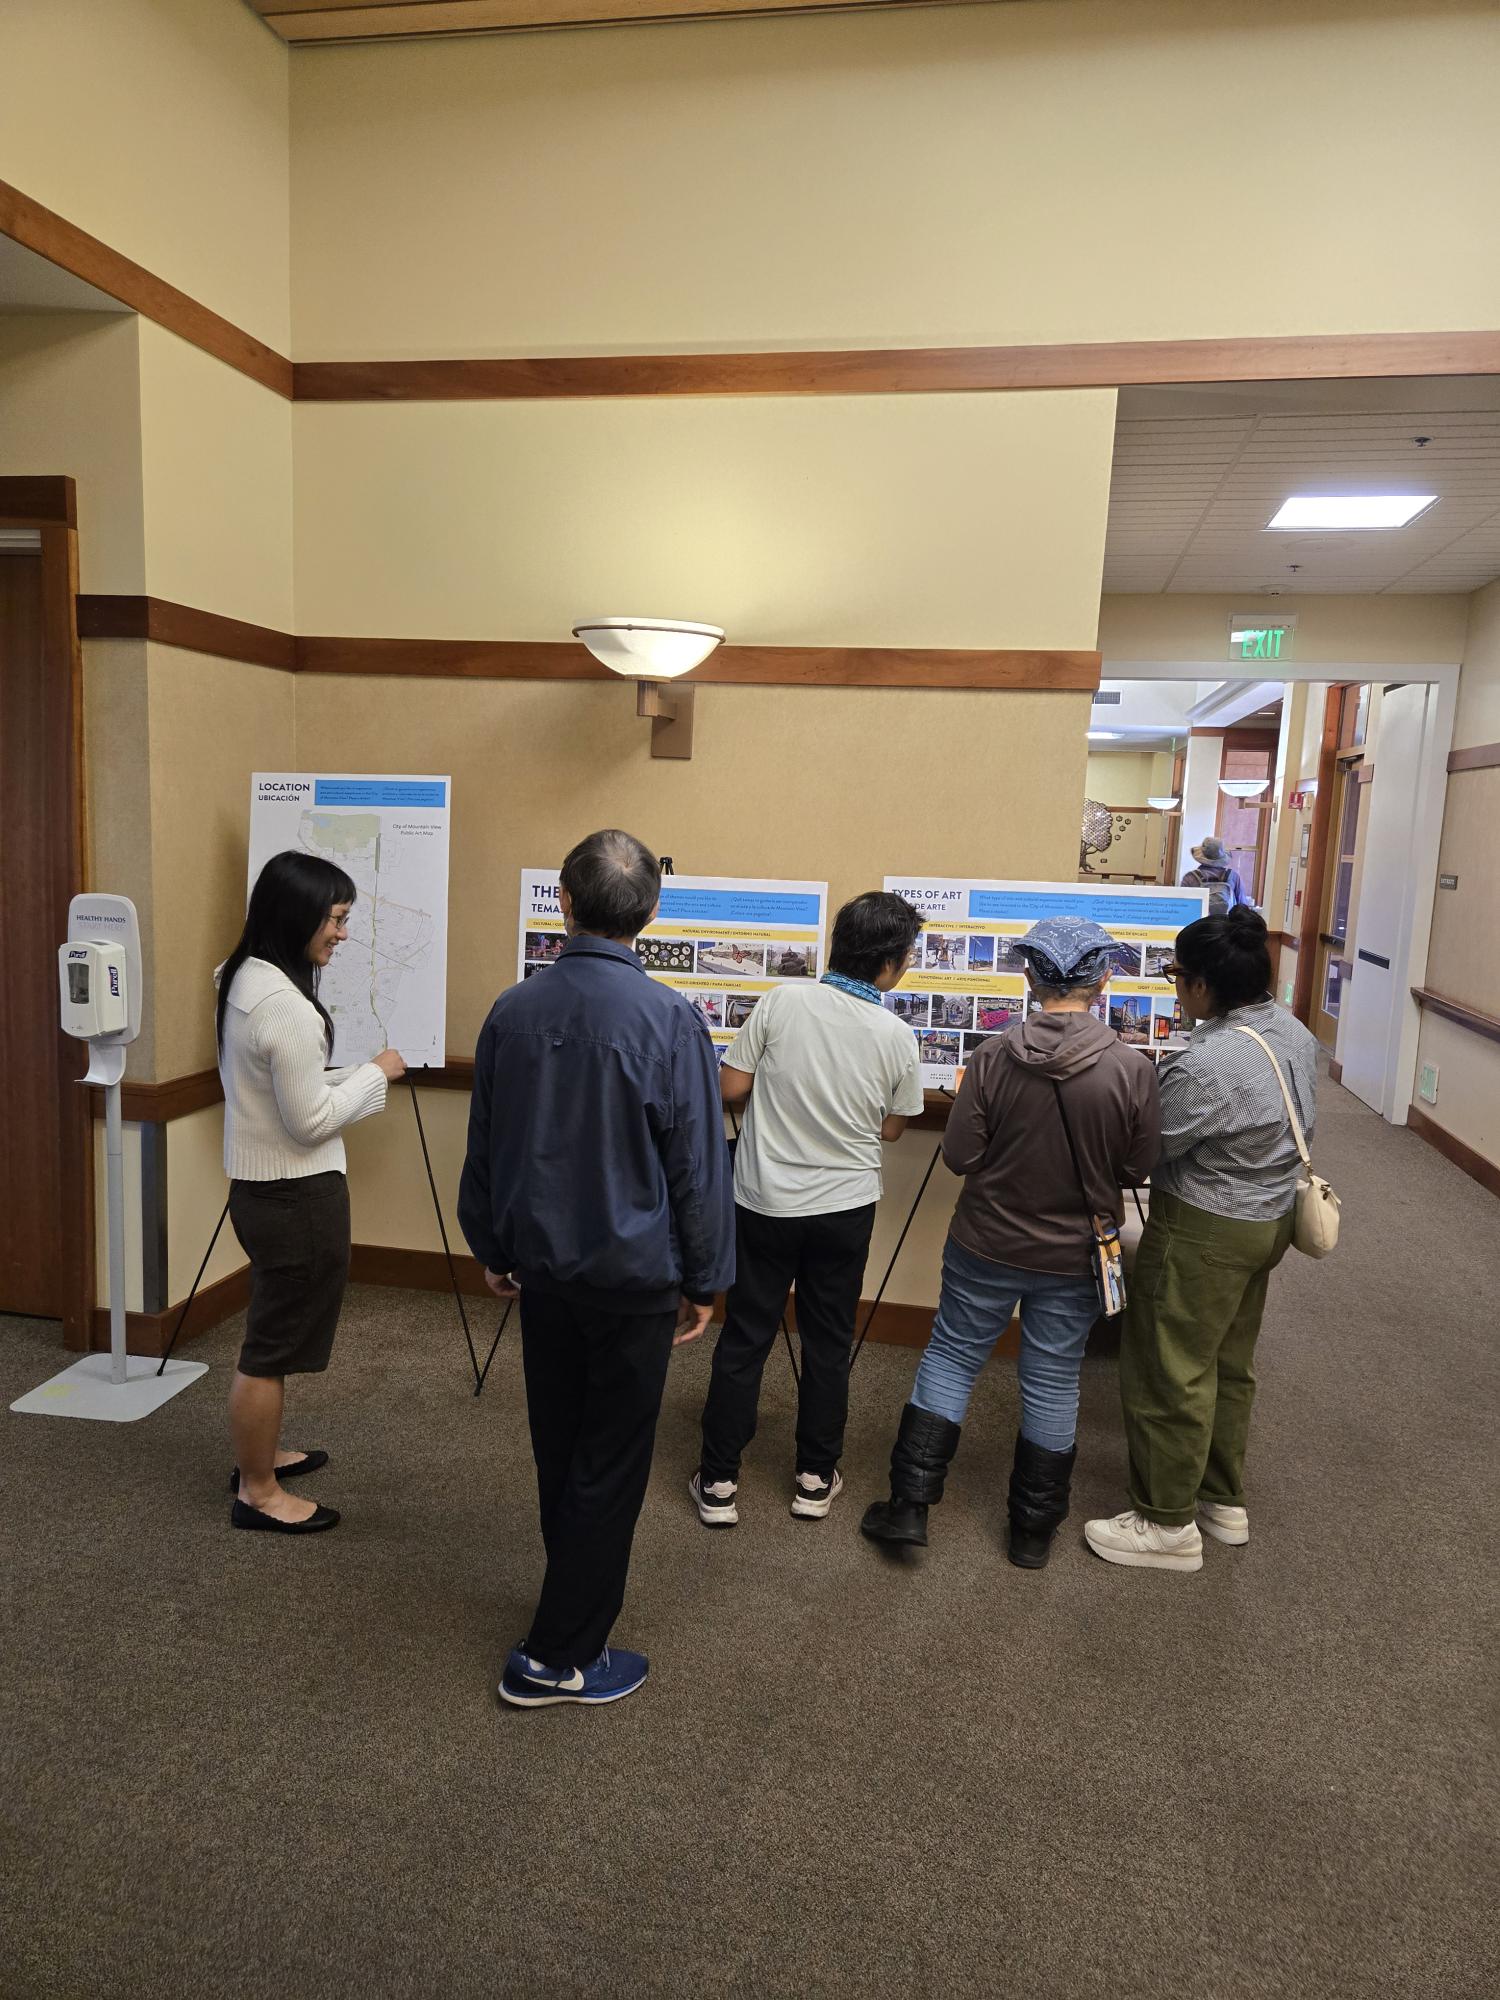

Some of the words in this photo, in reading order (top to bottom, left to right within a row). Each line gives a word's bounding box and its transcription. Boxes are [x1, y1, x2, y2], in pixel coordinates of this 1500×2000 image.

[1242, 629, 1284, 657] EXIT
[258, 782, 310, 792] LOCATION
[258, 793, 300, 802] UBICACIÓN
[892, 889, 922, 899] TYPES
[924, 890, 940, 899] OF
[941, 891, 962, 900] ART
[531, 903, 562, 913] TEMA
[926, 903, 946, 911] ARTE
[76, 914, 103, 922] HEALTHY
